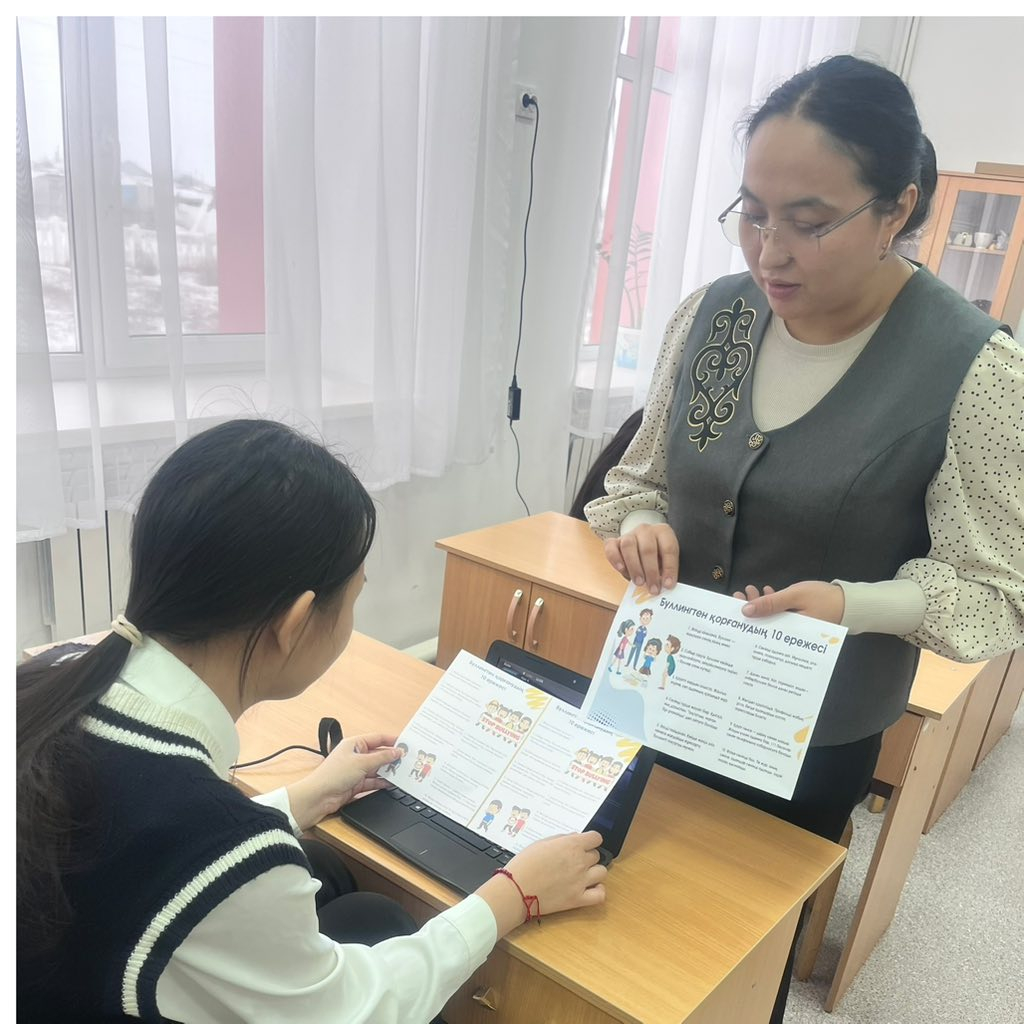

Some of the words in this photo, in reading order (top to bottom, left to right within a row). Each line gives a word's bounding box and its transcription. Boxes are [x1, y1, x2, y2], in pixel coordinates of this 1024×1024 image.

[660, 597, 709, 620] Буллингтен
[709, 614, 768, 640] қорғанудың
[771, 629, 783, 641] 10
[783, 635, 828, 654] ережесі
